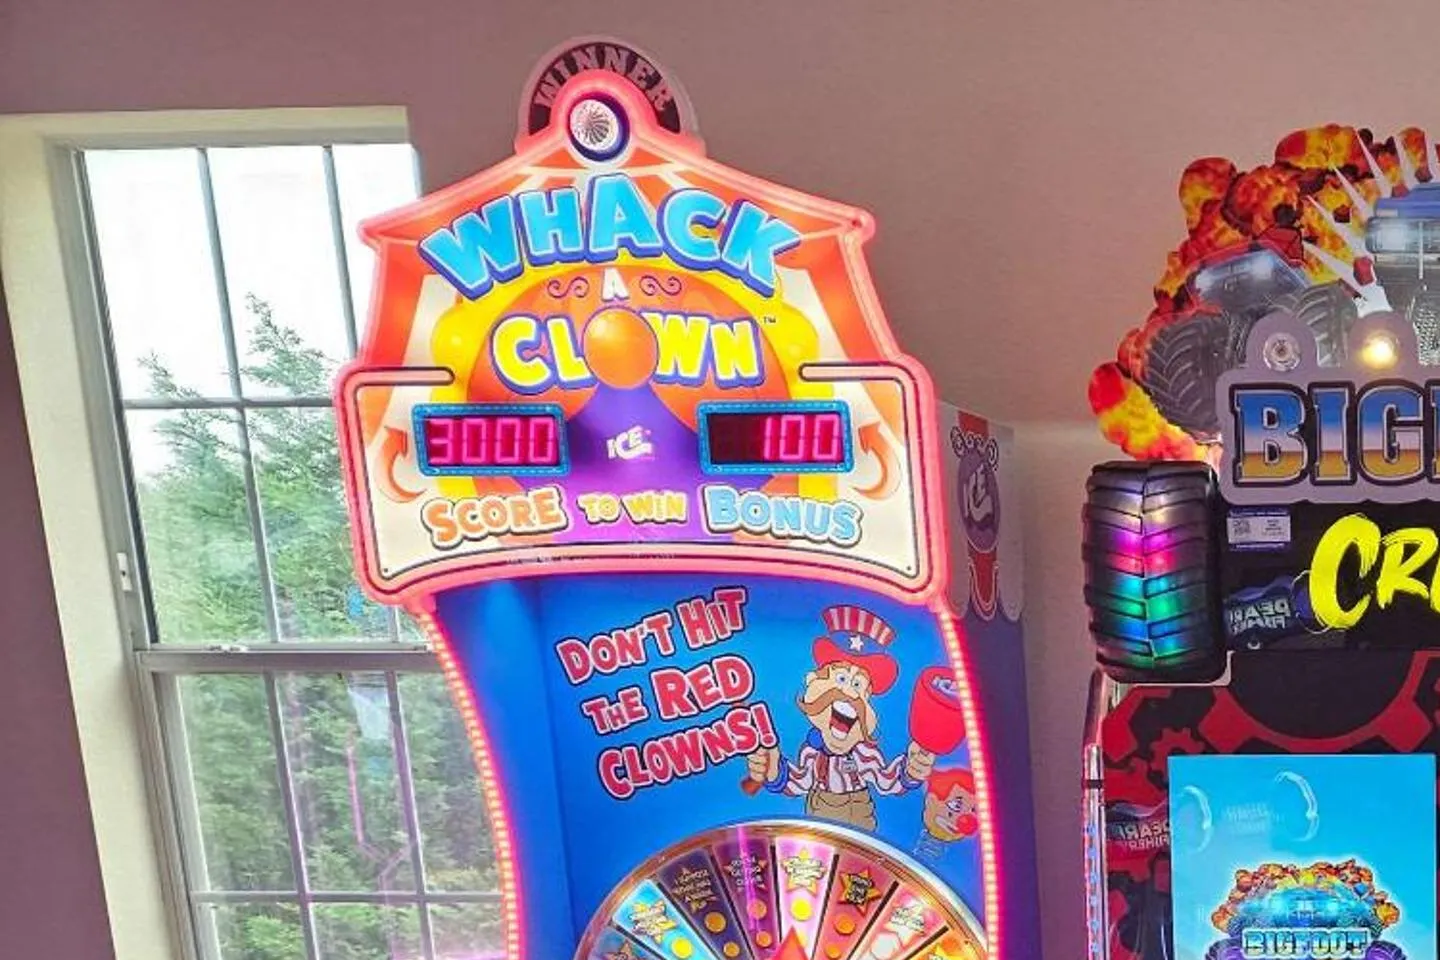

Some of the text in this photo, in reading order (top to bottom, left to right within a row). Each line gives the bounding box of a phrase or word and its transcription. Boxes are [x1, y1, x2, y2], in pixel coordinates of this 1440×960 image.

[531, 43, 677, 112] WINNER
[419, 172, 801, 299] WHACK
[600, 266, 631, 301] A
[430, 417, 556, 464] 3000
[763, 414, 840, 462] 100
[423, 487, 689, 545] SCORE TO WIN
[703, 486, 861, 546] BONUS
[555, 587, 749, 686] DON'T HIT
[582, 656, 756, 737] THE RED
[598, 703, 778, 800] CLOWNS!
[1243, 928, 1369, 959] BIGFOOT
